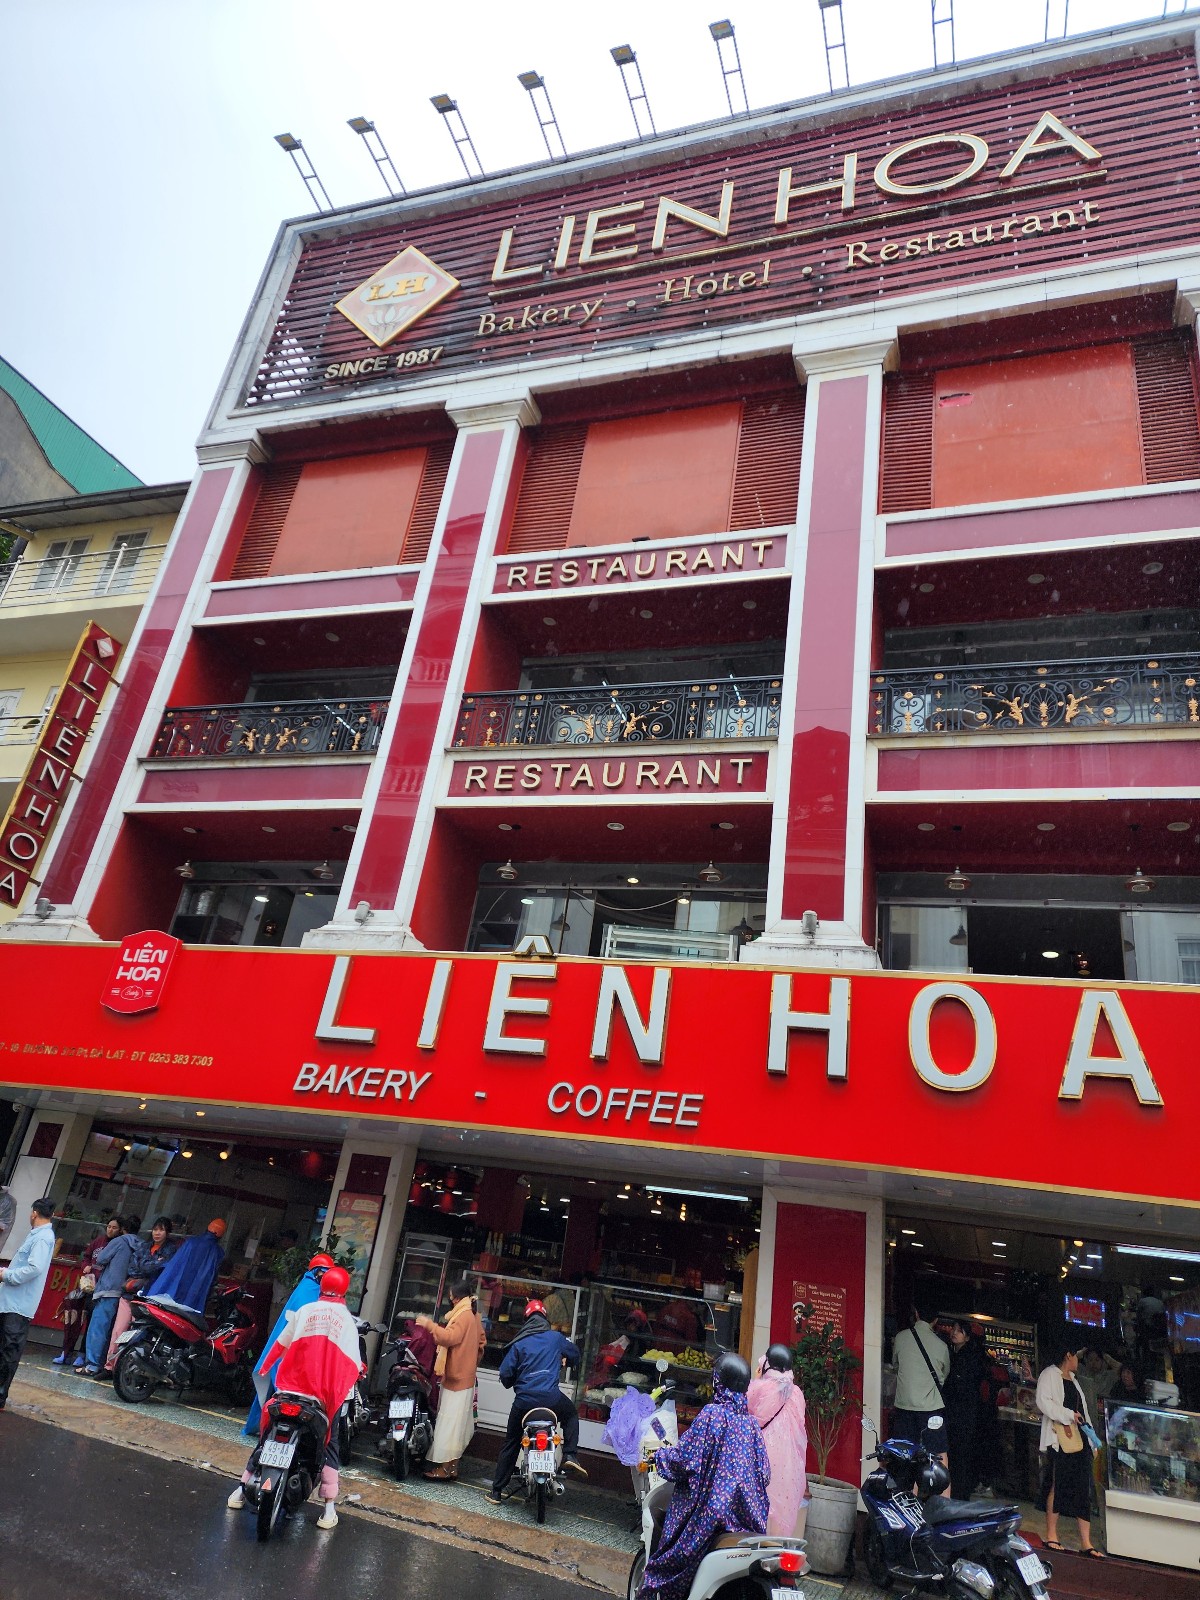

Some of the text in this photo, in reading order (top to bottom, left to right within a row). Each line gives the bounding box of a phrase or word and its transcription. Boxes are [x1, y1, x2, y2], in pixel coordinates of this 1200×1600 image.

[490, 110, 1102, 284] LIEN HOA
[366, 275, 429, 302] LH
[474, 200, 1100, 338] Bakery Hotel Restaurant
[324, 346, 444, 379] SINCE 1987
[507, 540, 773, 589] RESTAURANT
[37, 662, 98, 791] LIEN
[464, 758, 753, 791] RESTAURANT
[123, 942, 168, 964] LIÊN
[116, 966, 161, 982] HOA
[314, 935, 1165, 1107] LIÊN HOA
[172, 1054, 189, 1065] 383
[191, 1056, 214, 1066] 7303
[293, 1063, 432, 1101] BAKERY
[547, 1082, 704, 1127] COFFEE
